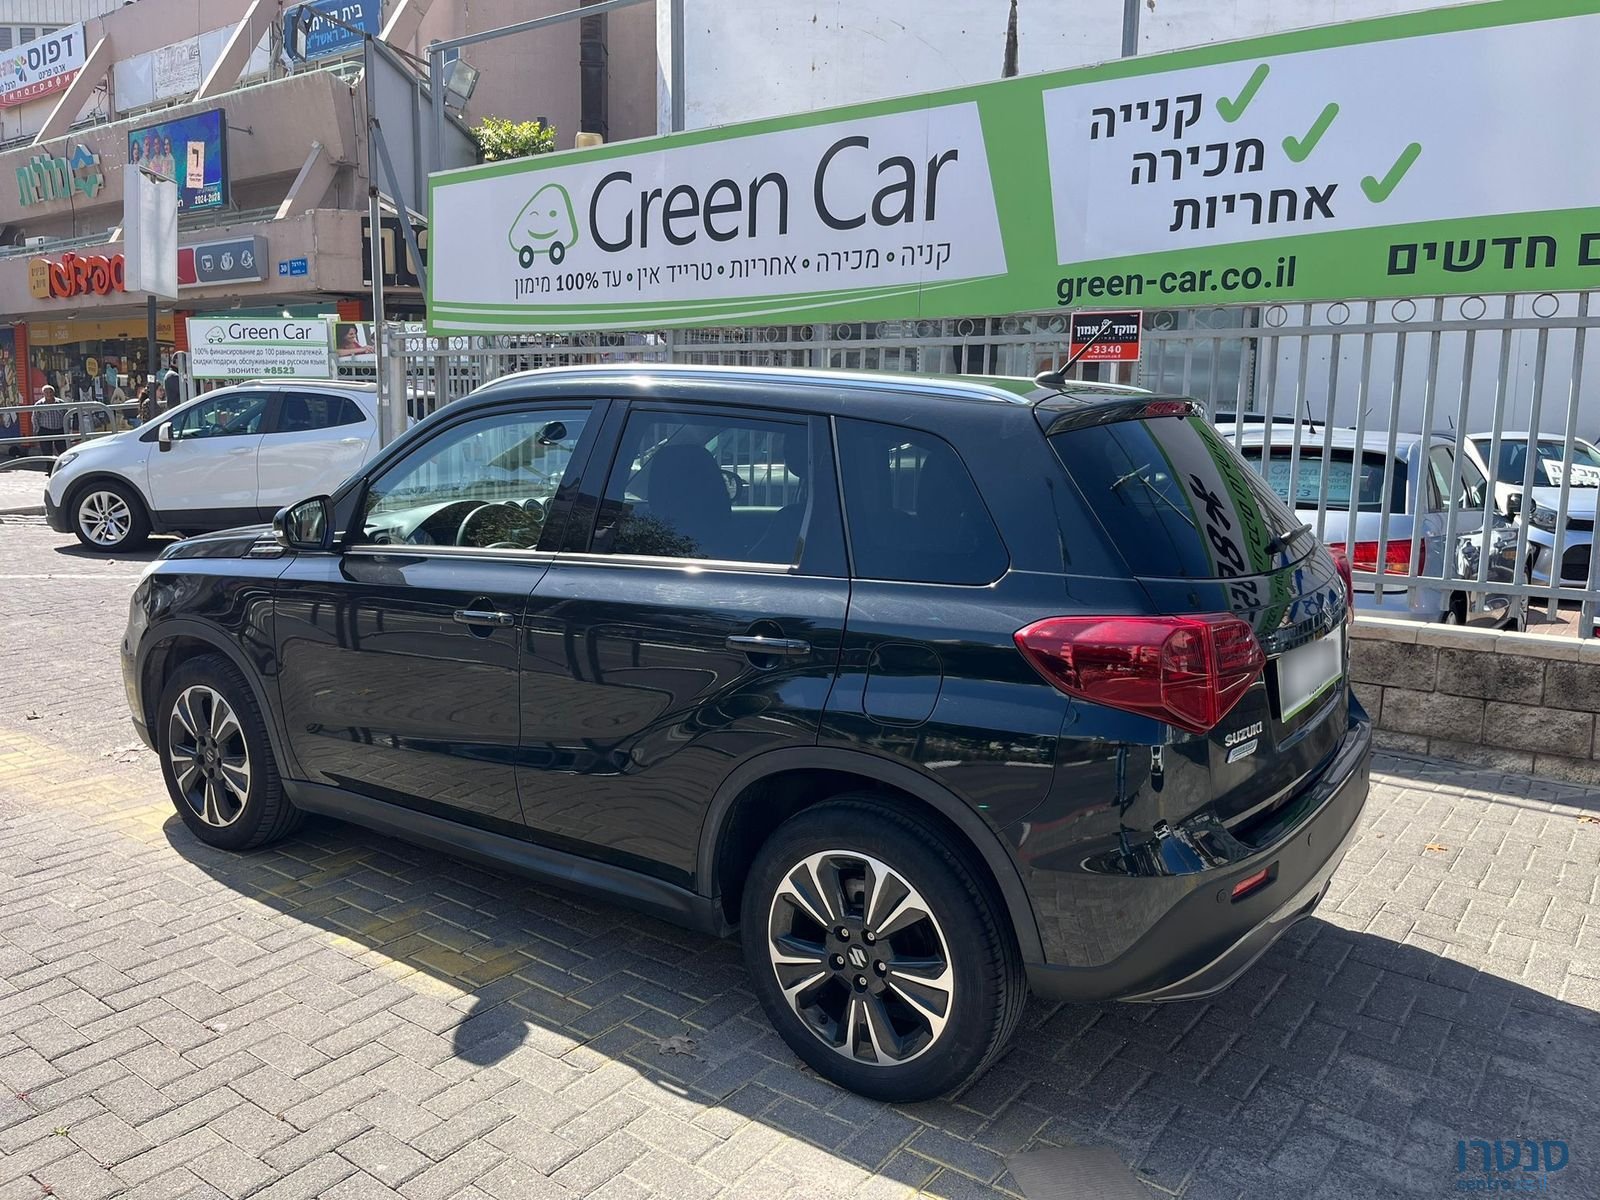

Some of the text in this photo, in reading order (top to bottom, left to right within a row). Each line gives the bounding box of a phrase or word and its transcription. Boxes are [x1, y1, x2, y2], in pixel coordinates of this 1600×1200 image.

[341, 4, 363, 22] בית
[27, 33, 73, 71] דפוס
[1090, 93, 1203, 140] קנייה
[1131, 137, 1266, 185] מכירה
[588, 135, 959, 253] Green Car
[1169, 183, 1339, 232] אחריות
[514, 242, 951, 300] קניה מכירה אחריות טרייד אין עד 100% מימון
[1387, 235, 1557, 276] חדשים
[1056, 255, 1297, 306] green-car.co.il
[228, 323, 312, 340] Green Car
[1077, 324, 1138, 337] מוקד אמון
[265, 348, 275, 356] 100
[1224, 720, 1263, 747] SUZUKI
